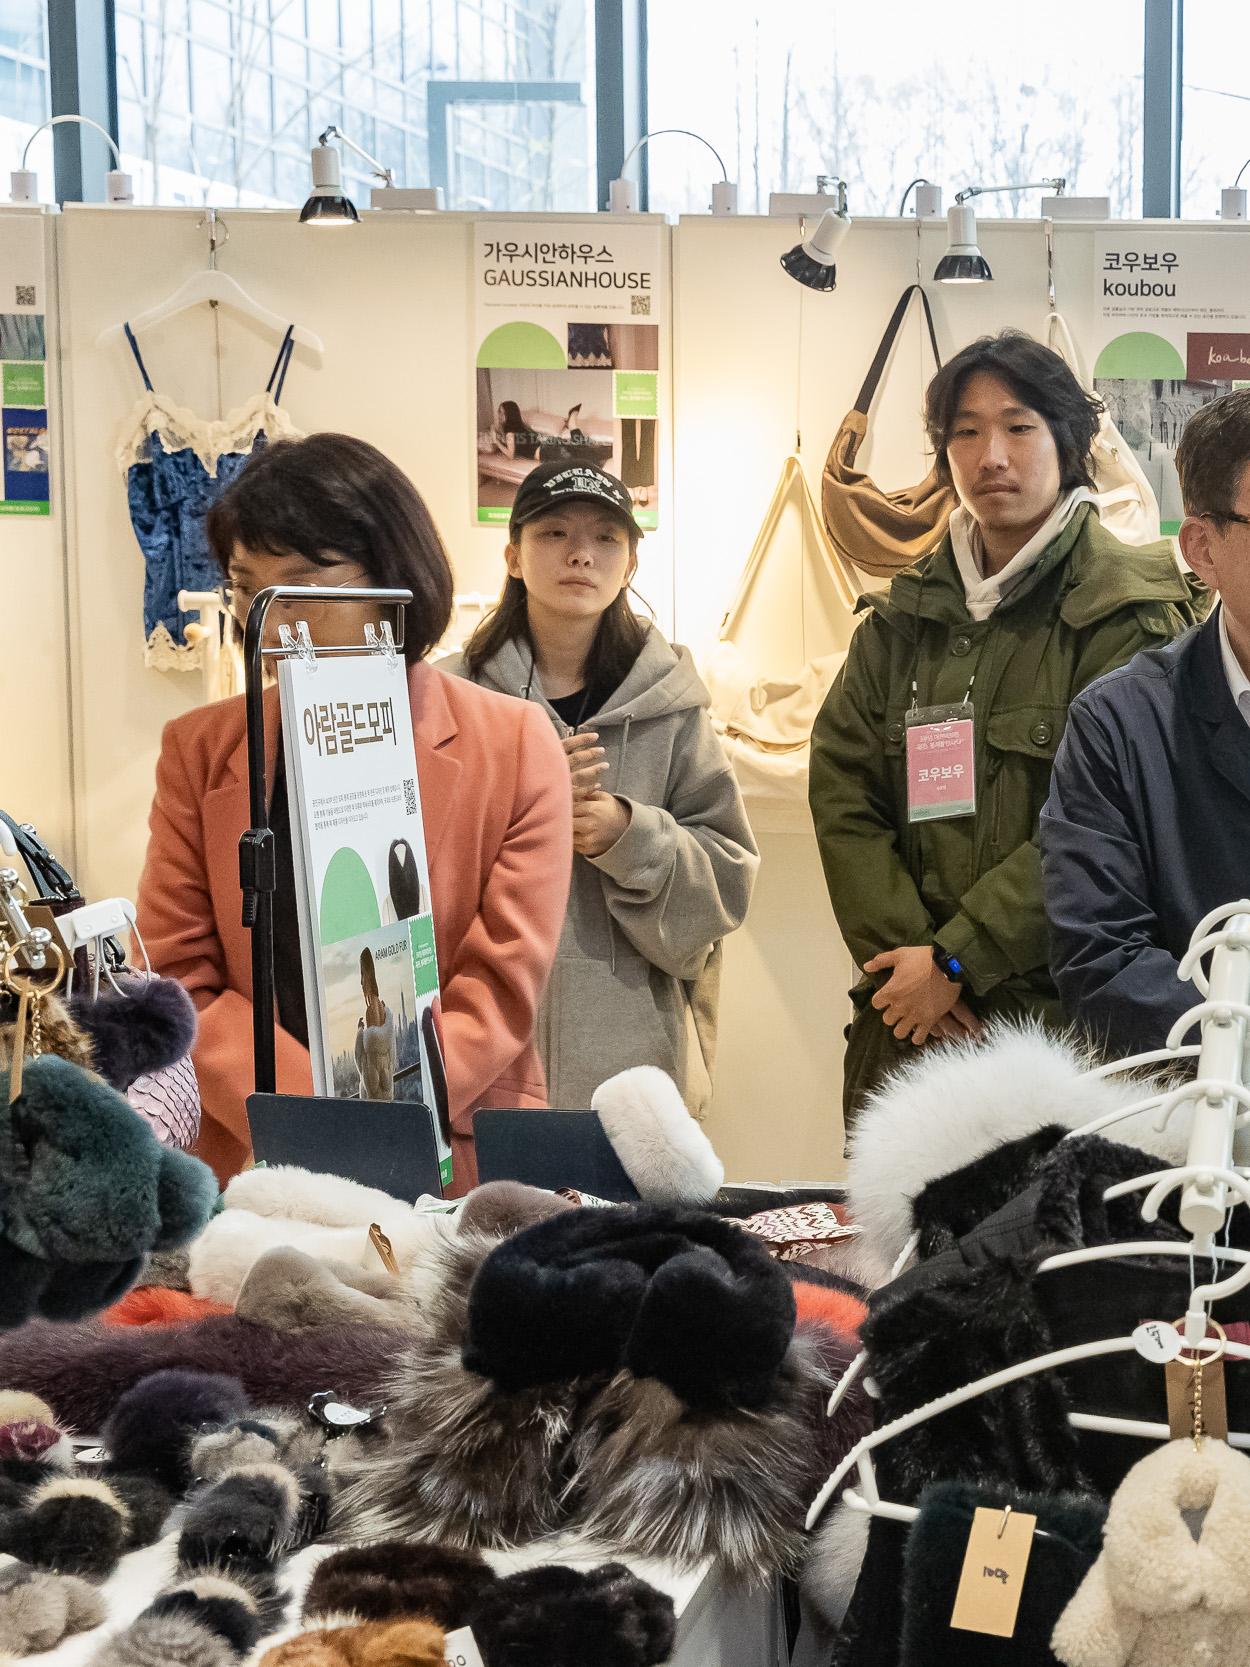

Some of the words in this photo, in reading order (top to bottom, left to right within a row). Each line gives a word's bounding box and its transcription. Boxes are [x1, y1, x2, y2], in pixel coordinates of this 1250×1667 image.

[483, 241, 614, 265] 가우시안하우스
[1102, 251, 1179, 274] 코우보우
[483, 269, 651, 290] GAUSSIANHOUSE
[1103, 278, 1176, 297] koubou
[303, 696, 397, 756] 아람골드모피
[917, 764, 965, 783] 코우보우
